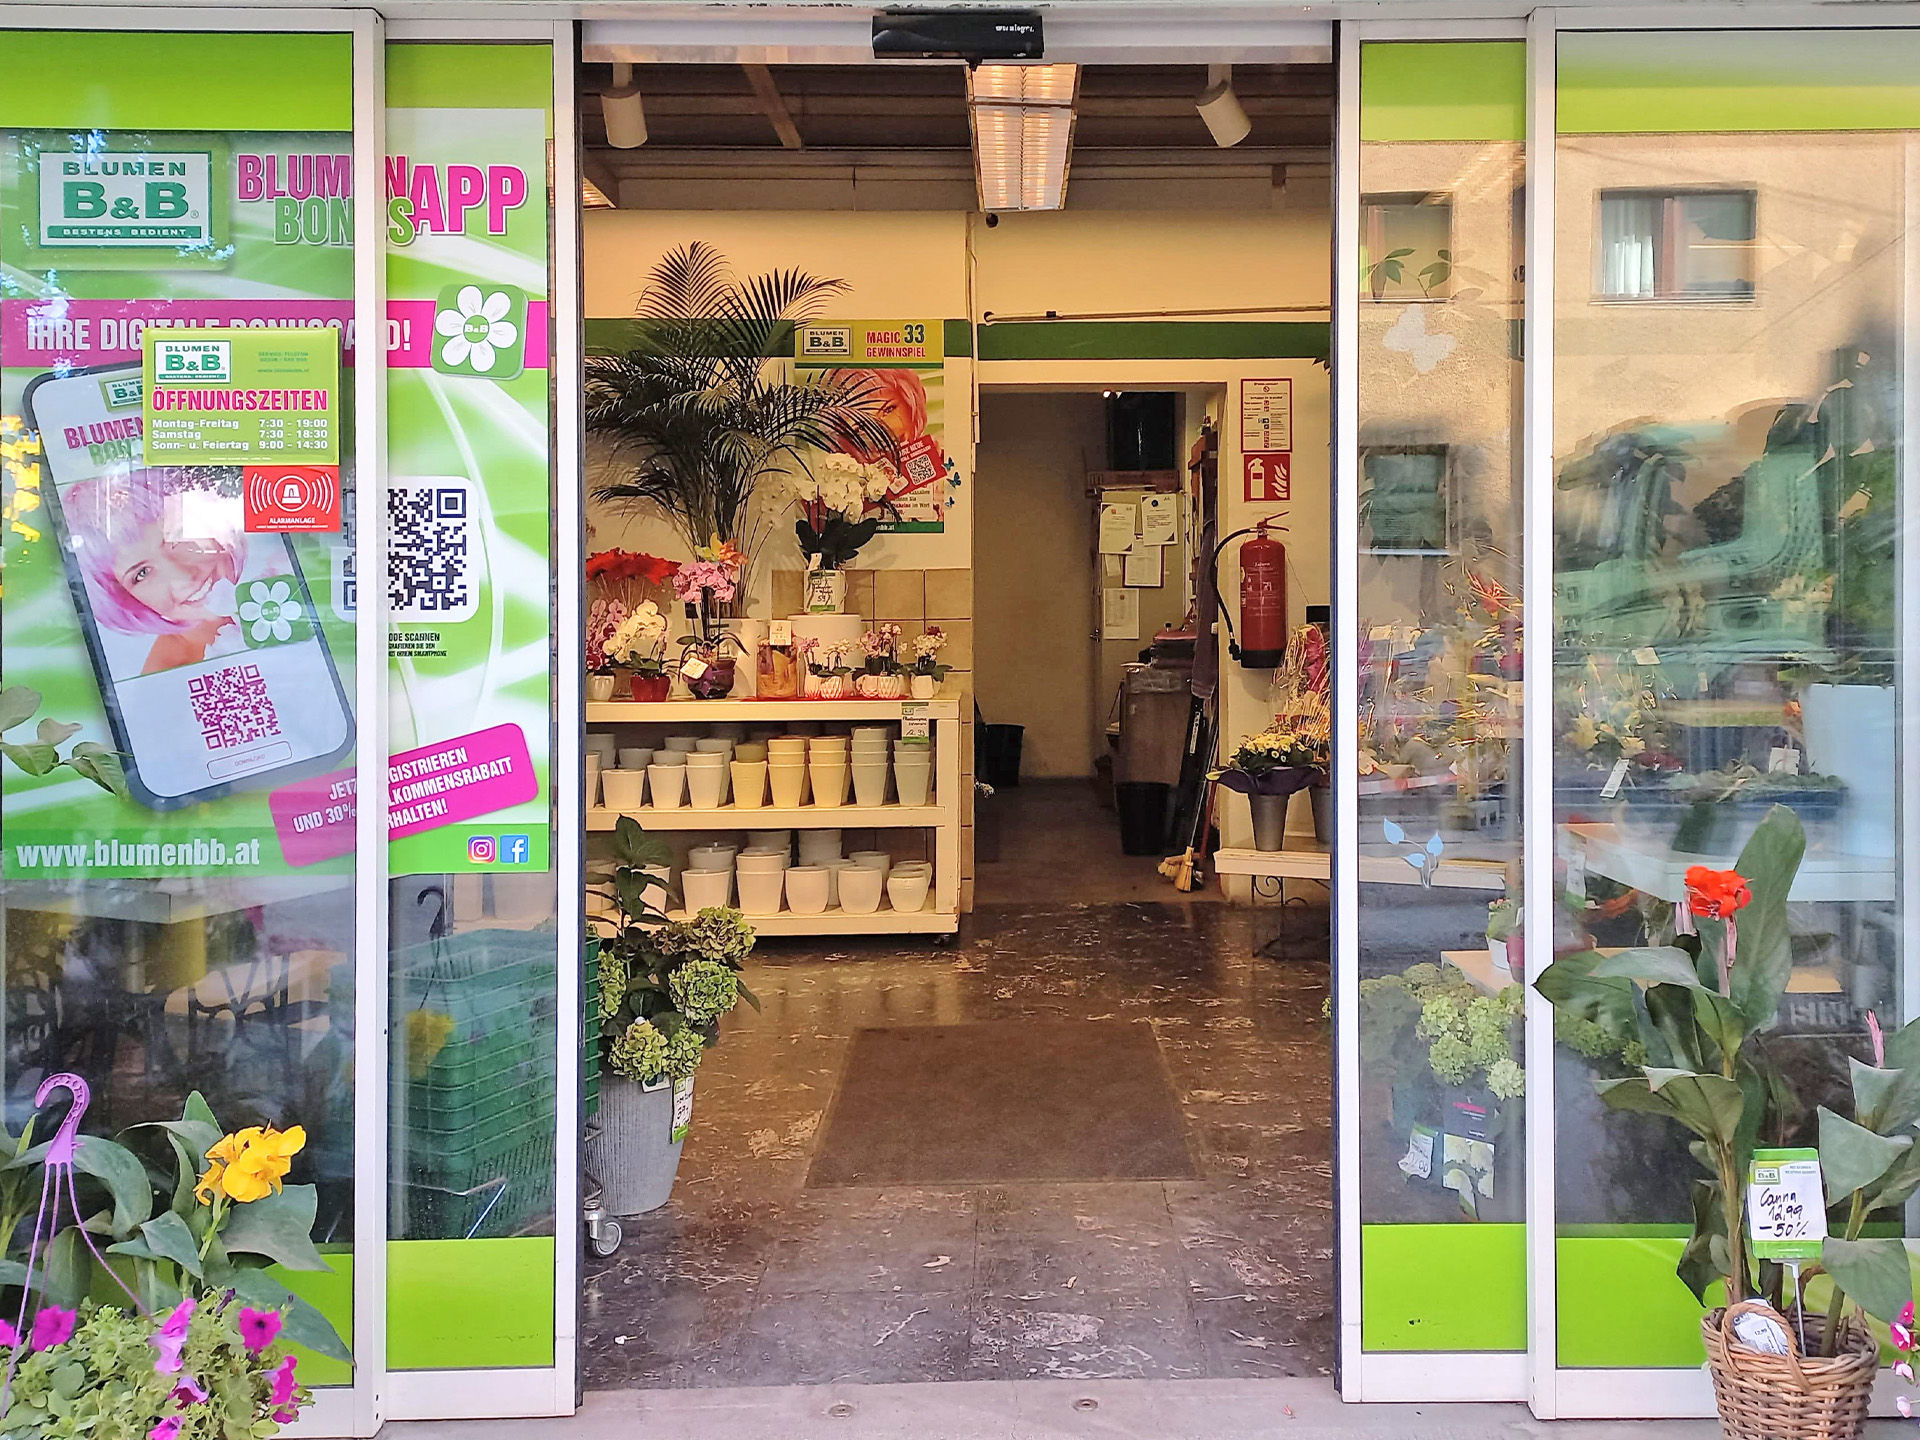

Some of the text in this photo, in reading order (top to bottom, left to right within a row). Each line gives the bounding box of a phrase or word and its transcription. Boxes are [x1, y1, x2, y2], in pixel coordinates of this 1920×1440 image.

[62, 161, 186, 177] BLUMEN
[237, 154, 409, 201] BLUMN
[63, 181, 189, 219] B&B
[410, 163, 527, 235] APP
[274, 195, 415, 245] BONS
[63, 228, 187, 236] BESTENS BEDIENT
[809, 336, 844, 348] B&B
[866, 324, 925, 344] MAGIC 33
[866, 346, 926, 358] GEWINNSPIEL
[165, 354, 221, 371] B&B
[152, 386, 328, 411] ÖFFNUNGSZEITEN
[152, 418, 240, 430] Montag-Freitag
[259, 419, 284, 428] 7:30
[296, 419, 328, 428] 19:00
[152, 430, 202, 440] Samstag
[259, 430, 284, 438] 7:30
[296, 430, 328, 438] 18:30
[152, 440, 185, 450] Sonn-
[202, 440, 250, 451] Feiertag
[259, 440, 284, 449] 9:00
[296, 440, 328, 449] 14:30
[388, 632, 441, 641] ODE SCANNEN
[328, 746, 469, 801] JETZ GISTRIEREN
[292, 756, 513, 833] UND 30% LKOMMENSRABATT
[388, 797, 449, 830] RHALTEN!
[16, 838, 260, 868] www.blumenbb.at
